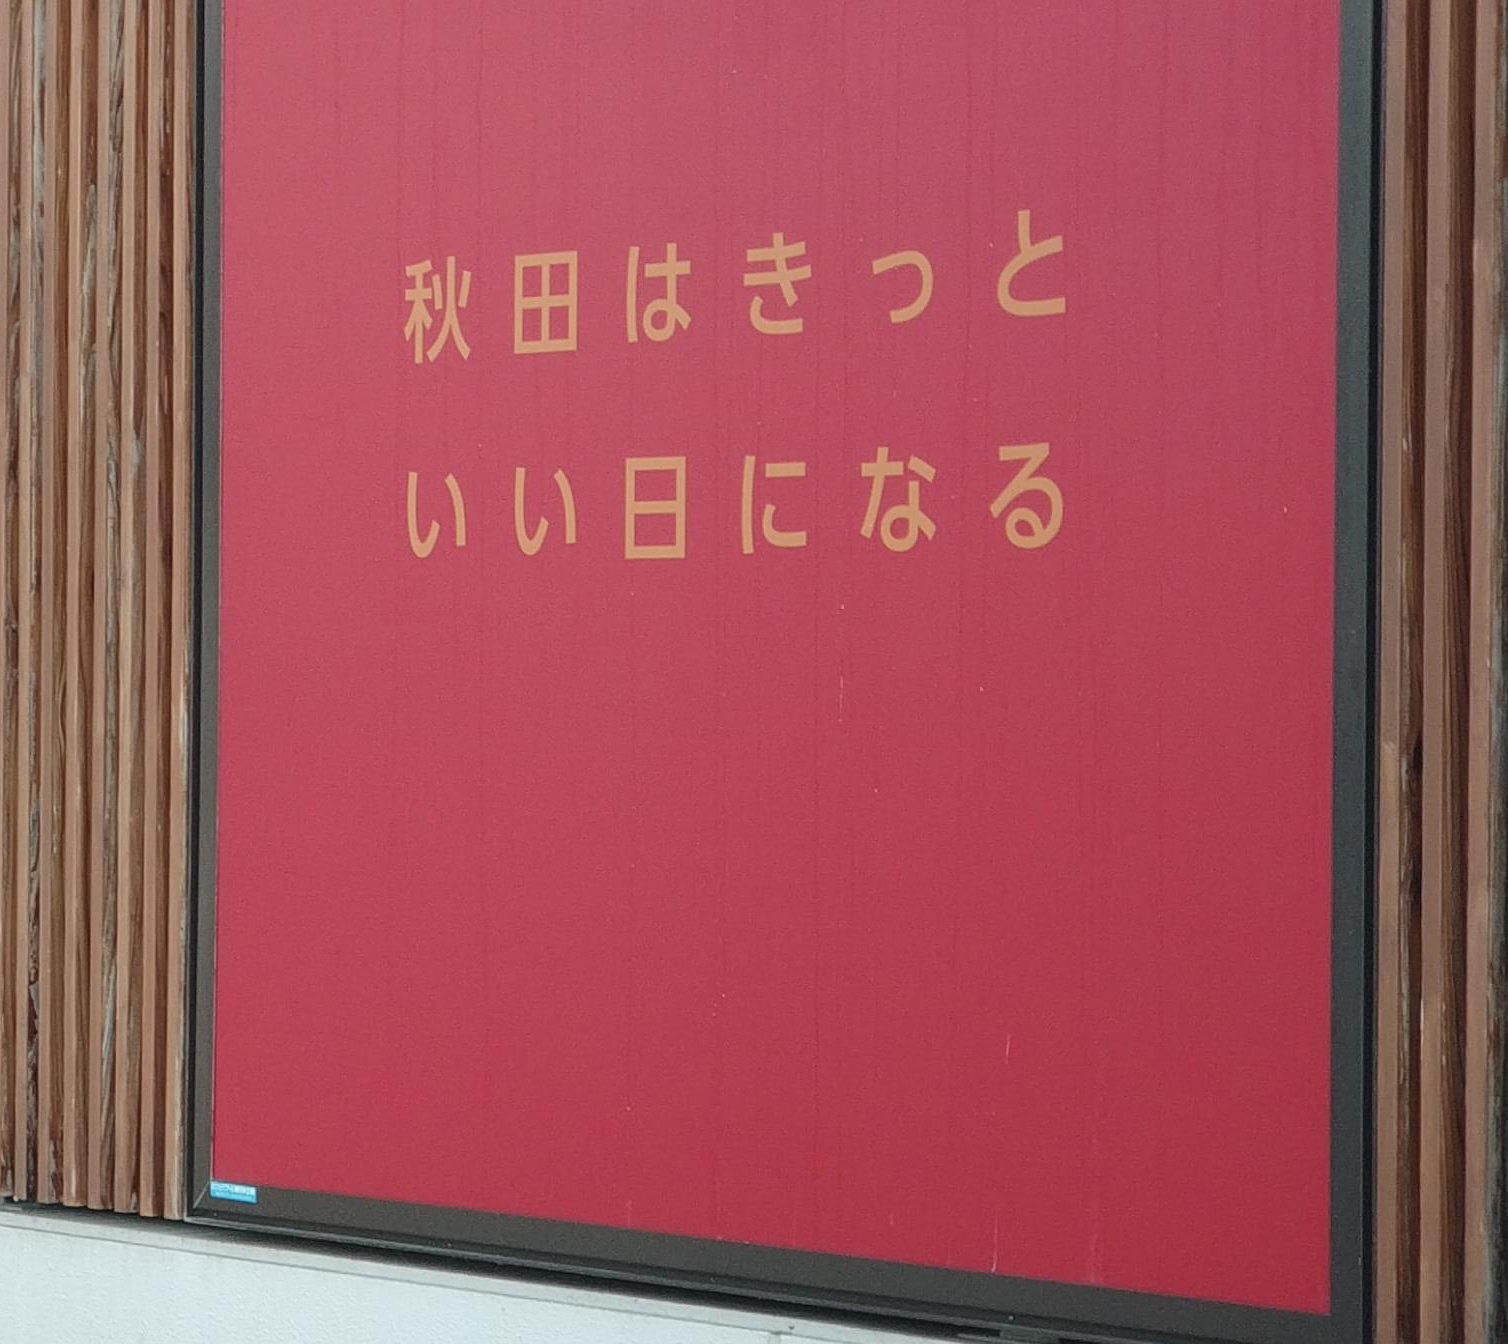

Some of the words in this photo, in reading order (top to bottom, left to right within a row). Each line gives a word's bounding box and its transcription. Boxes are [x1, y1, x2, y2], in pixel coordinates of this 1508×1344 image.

[403, 209, 1067, 364] 秋田はきっと
[406, 442, 1065, 560] いい日になる
